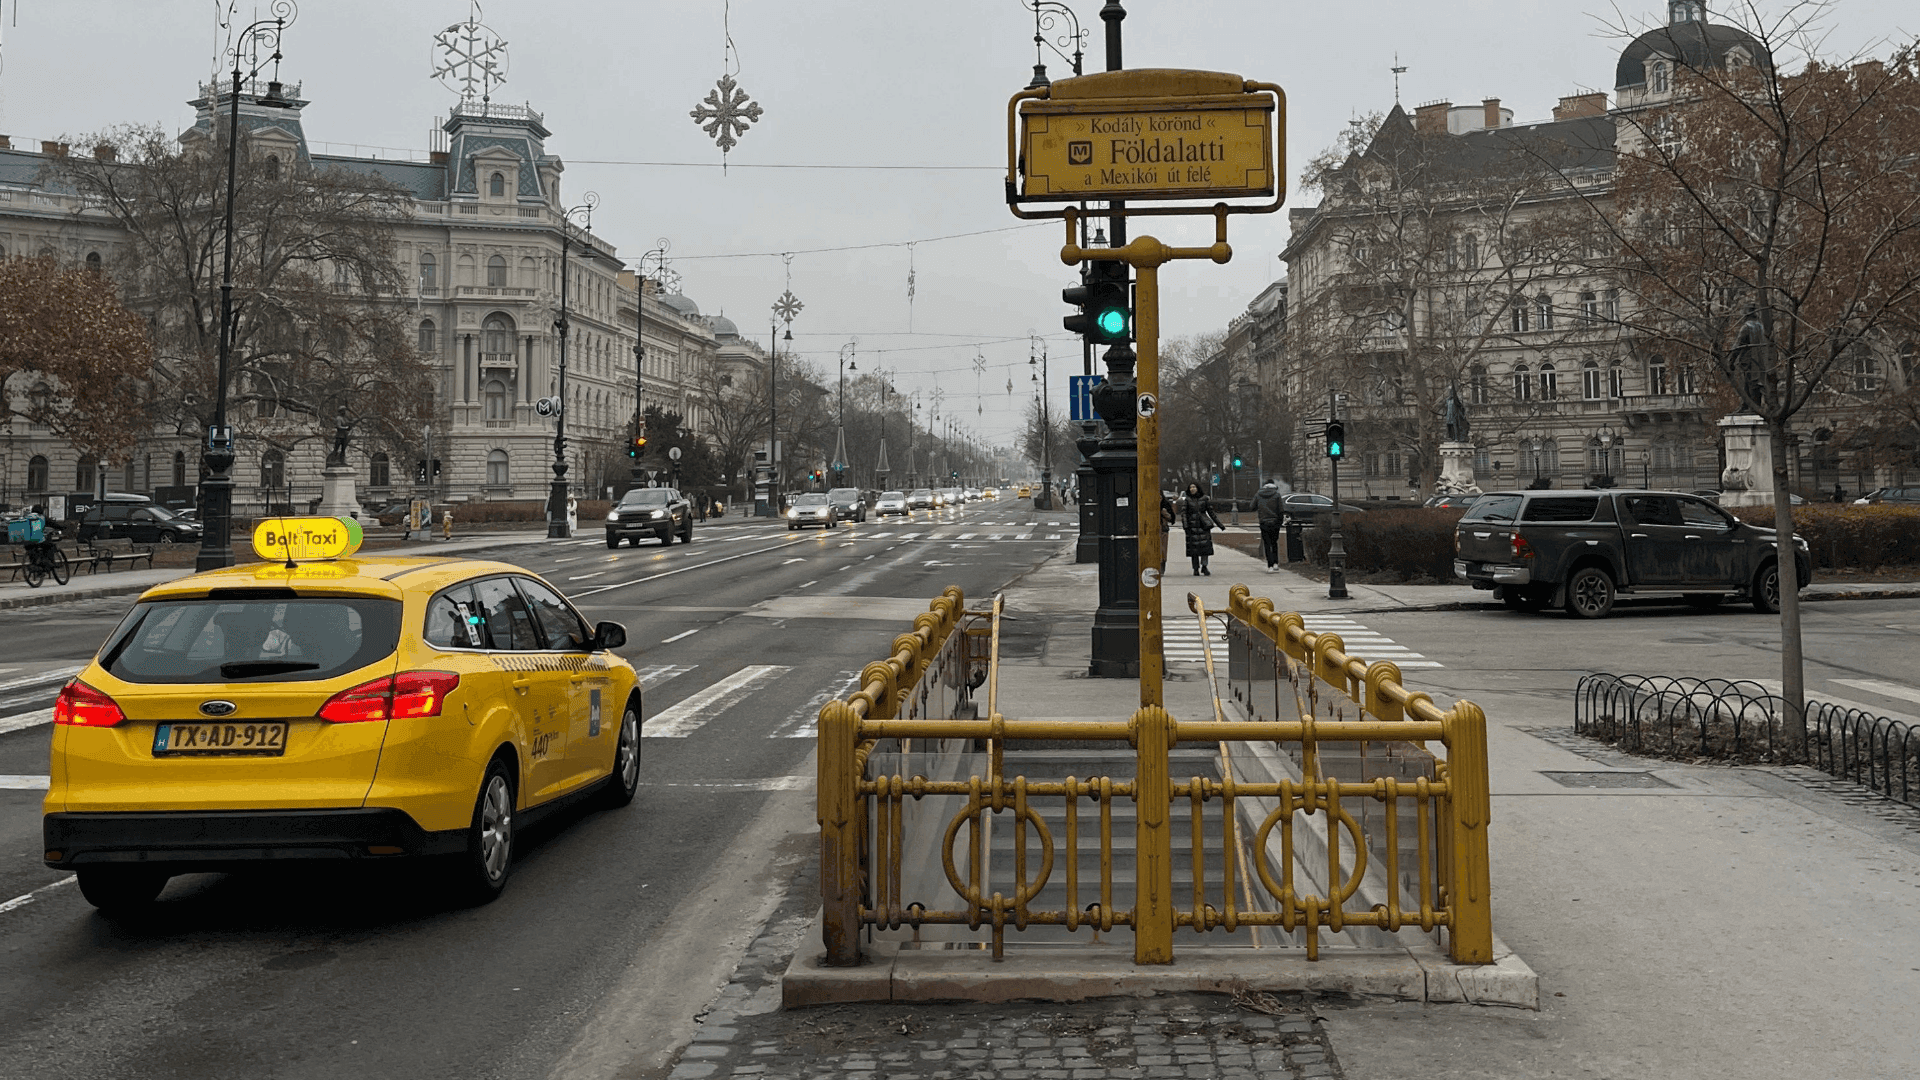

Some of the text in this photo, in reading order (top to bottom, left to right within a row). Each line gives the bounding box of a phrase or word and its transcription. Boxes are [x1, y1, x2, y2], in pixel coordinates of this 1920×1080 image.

[1090, 118, 1143, 136] Kodály
[1149, 115, 1202, 132] körönd
[1110, 136, 1225, 164] Földalatti
[1084, 165, 1211, 186] a Mexikói út felé
[266, 528, 337, 546] Bolt Taxi
[173, 726, 200, 747] TX
[207, 725, 282, 747] AD-912
